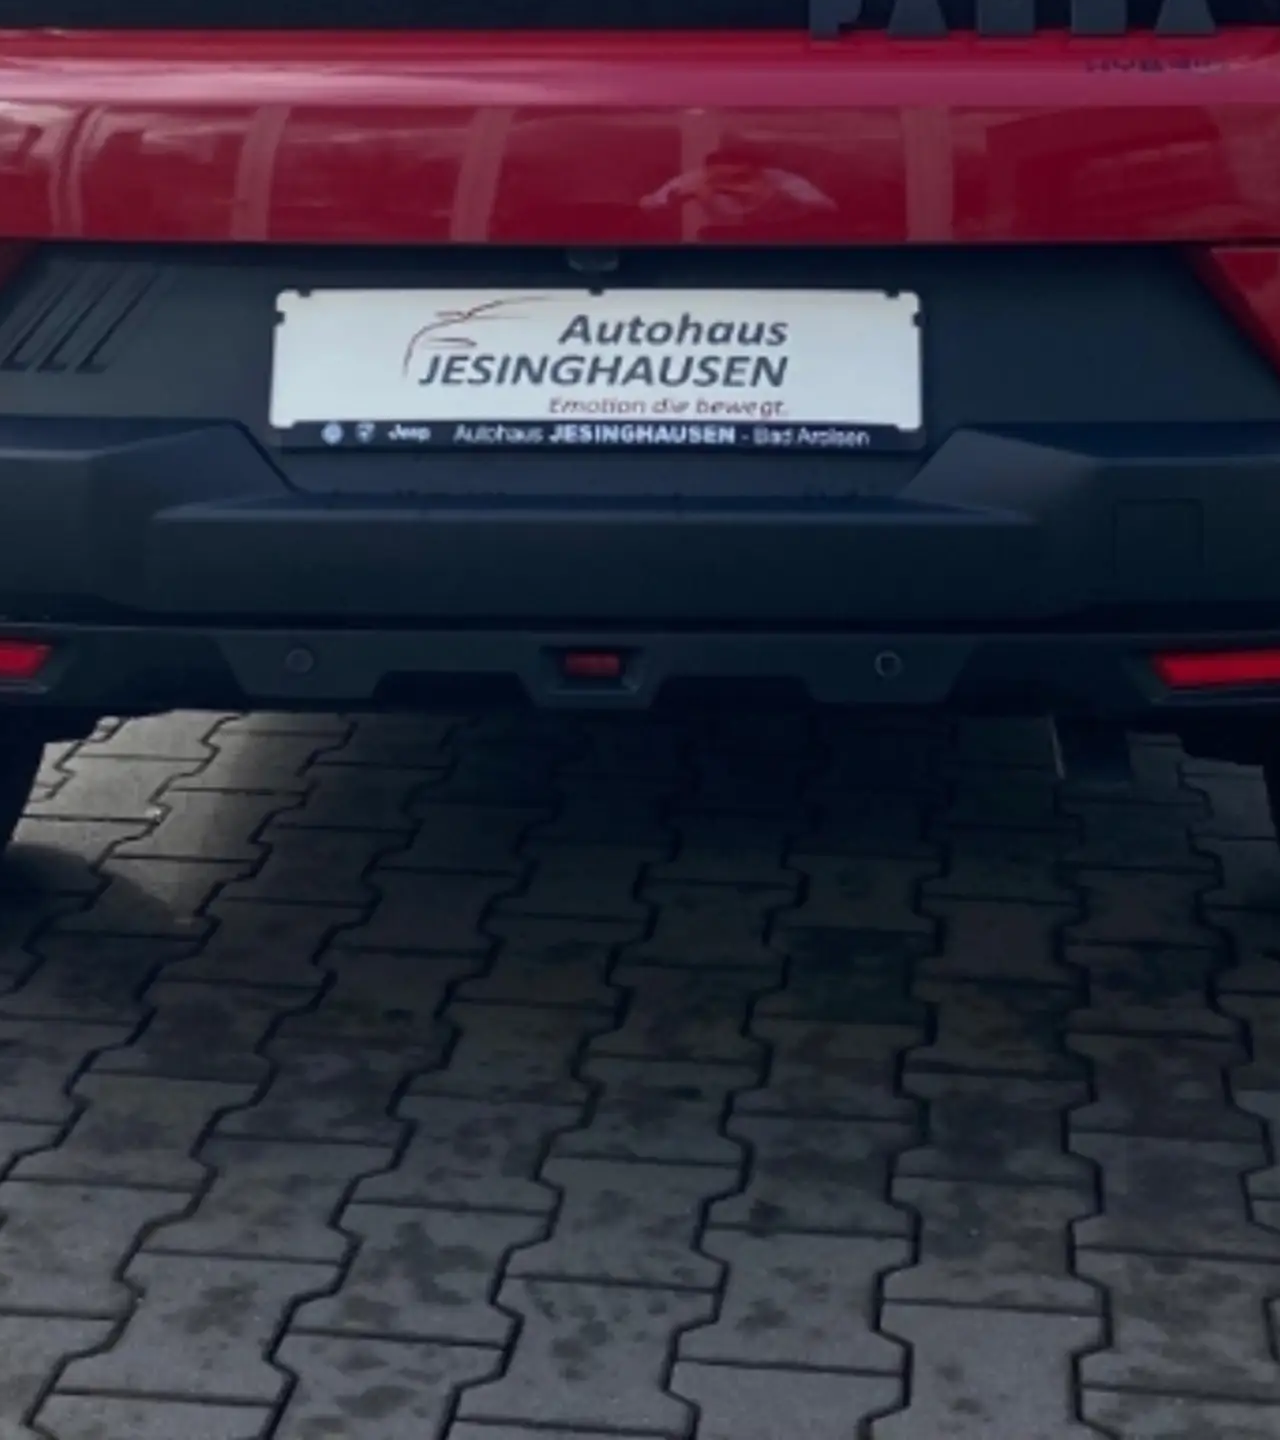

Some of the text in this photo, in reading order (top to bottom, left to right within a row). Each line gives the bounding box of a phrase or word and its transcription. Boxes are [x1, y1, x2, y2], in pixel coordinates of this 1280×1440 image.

[557, 312, 789, 347] Autohaus
[418, 354, 789, 388] JESINGHAUSEN
[548, 396, 646, 415] Emotion
[651, 396, 689, 415] die
[452, 423, 544, 445] Autohaus
[548, 423, 736, 445] JESINGHAUSEN
